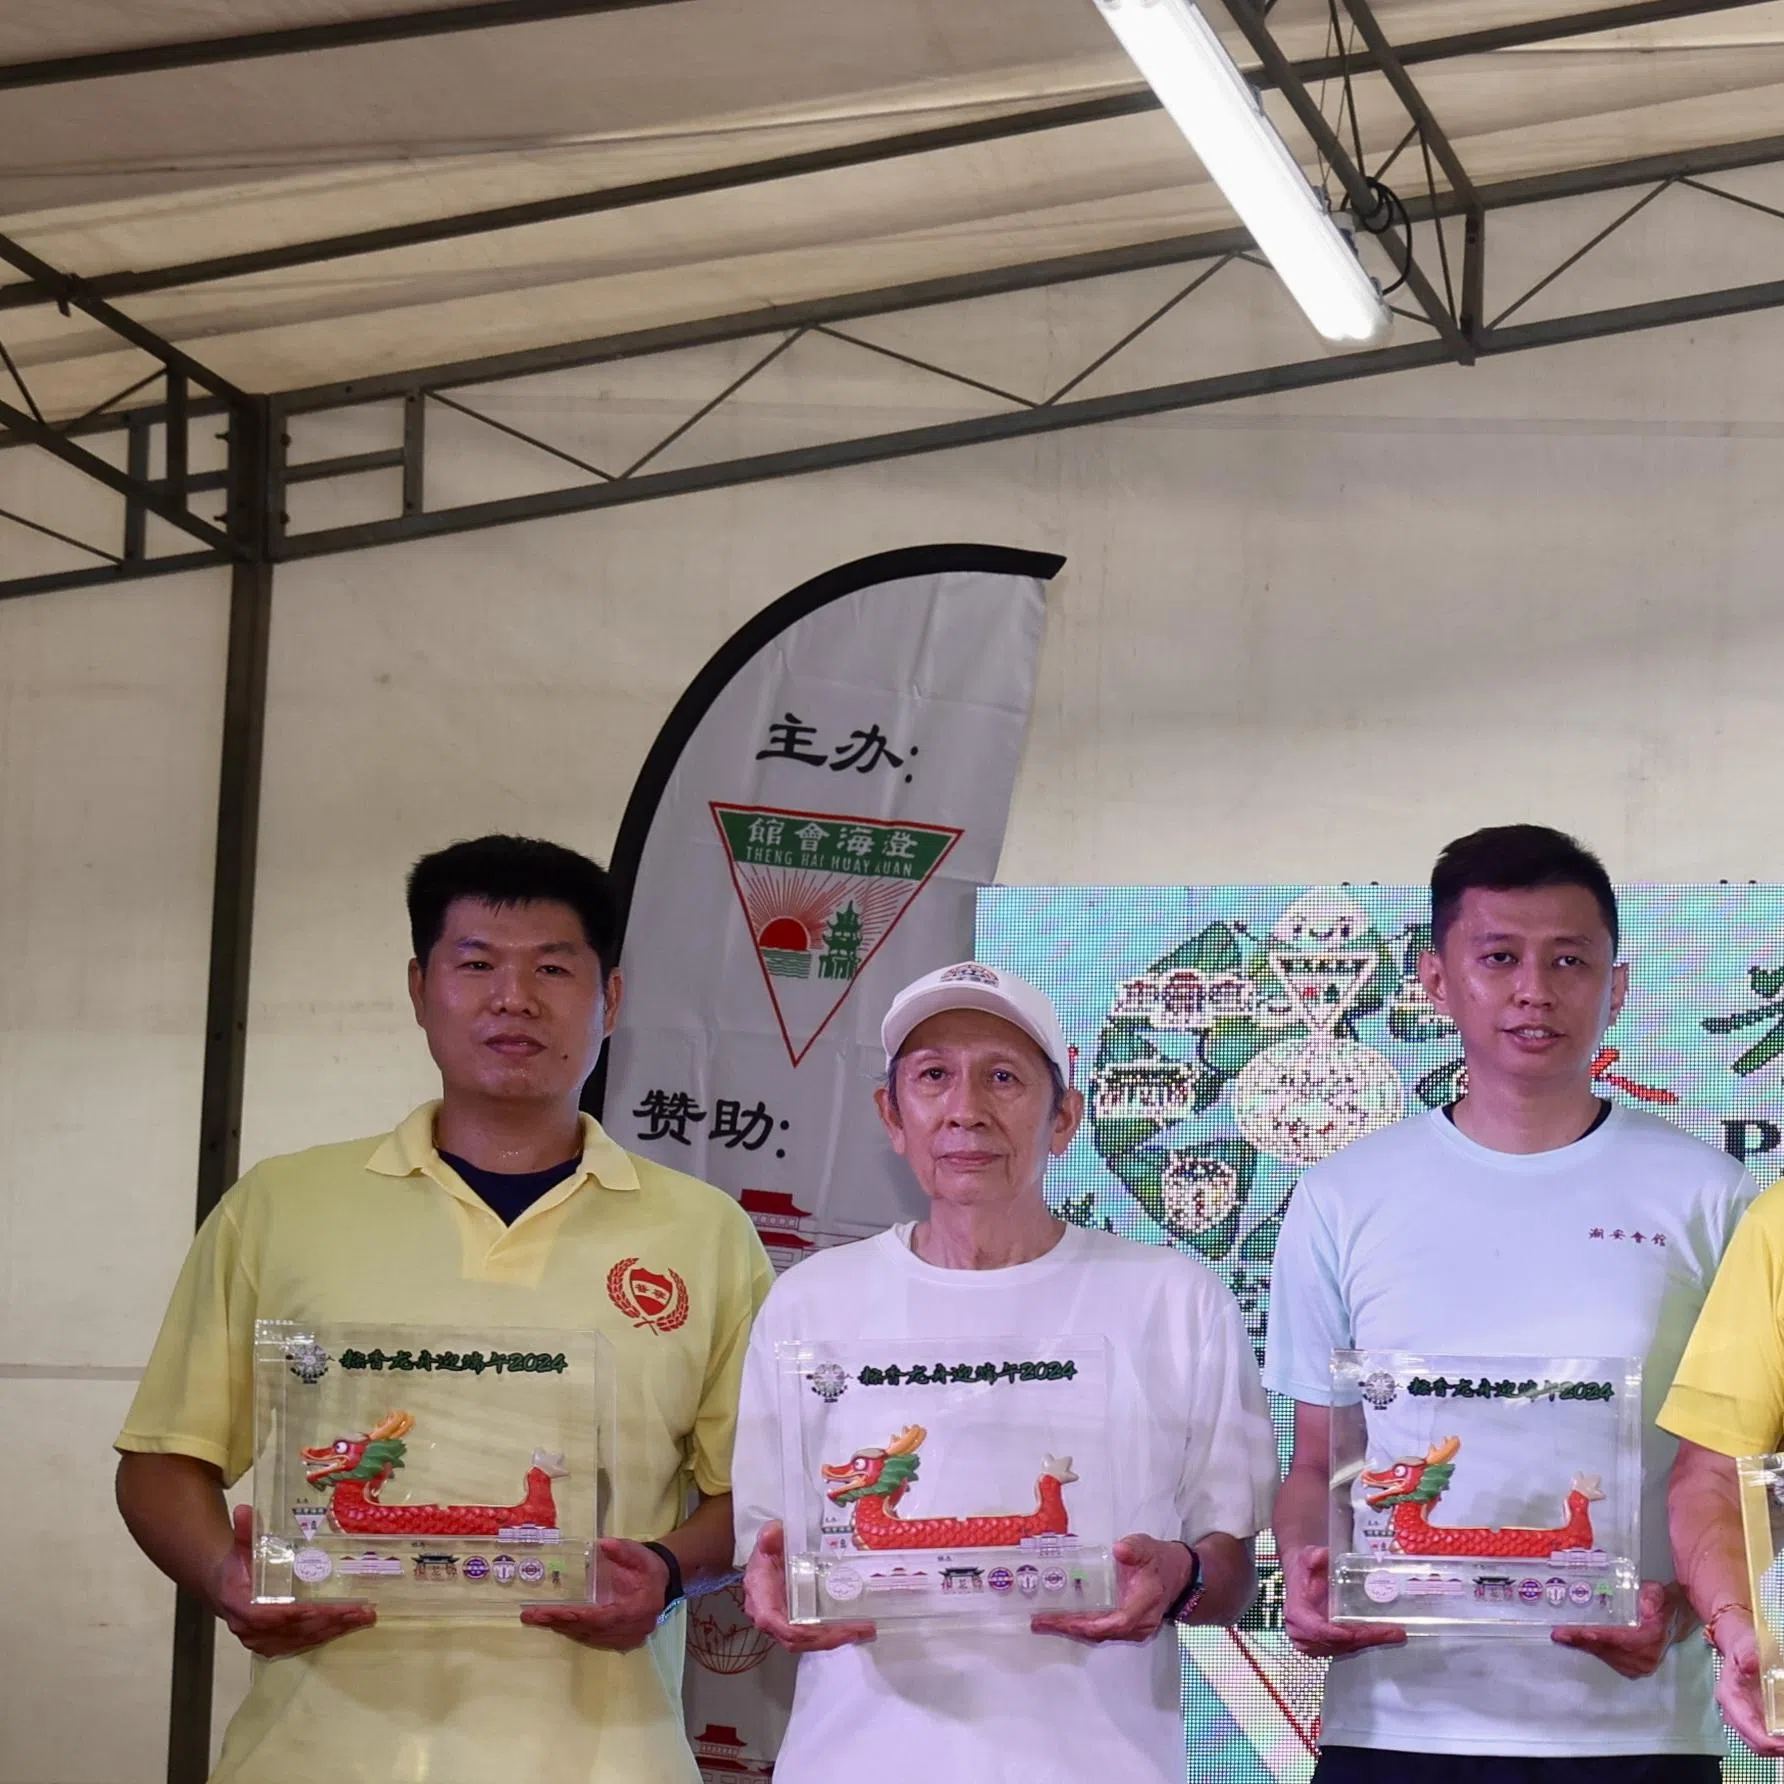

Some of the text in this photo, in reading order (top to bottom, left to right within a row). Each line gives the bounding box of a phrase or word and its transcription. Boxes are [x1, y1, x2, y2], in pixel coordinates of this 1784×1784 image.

[756, 714, 918, 783] 主办:
[746, 847, 792, 866] THENG
[801, 854, 824, 868] HAI
[831, 855, 870, 874] HUAY
[633, 1089, 790, 1158] 赞助:
